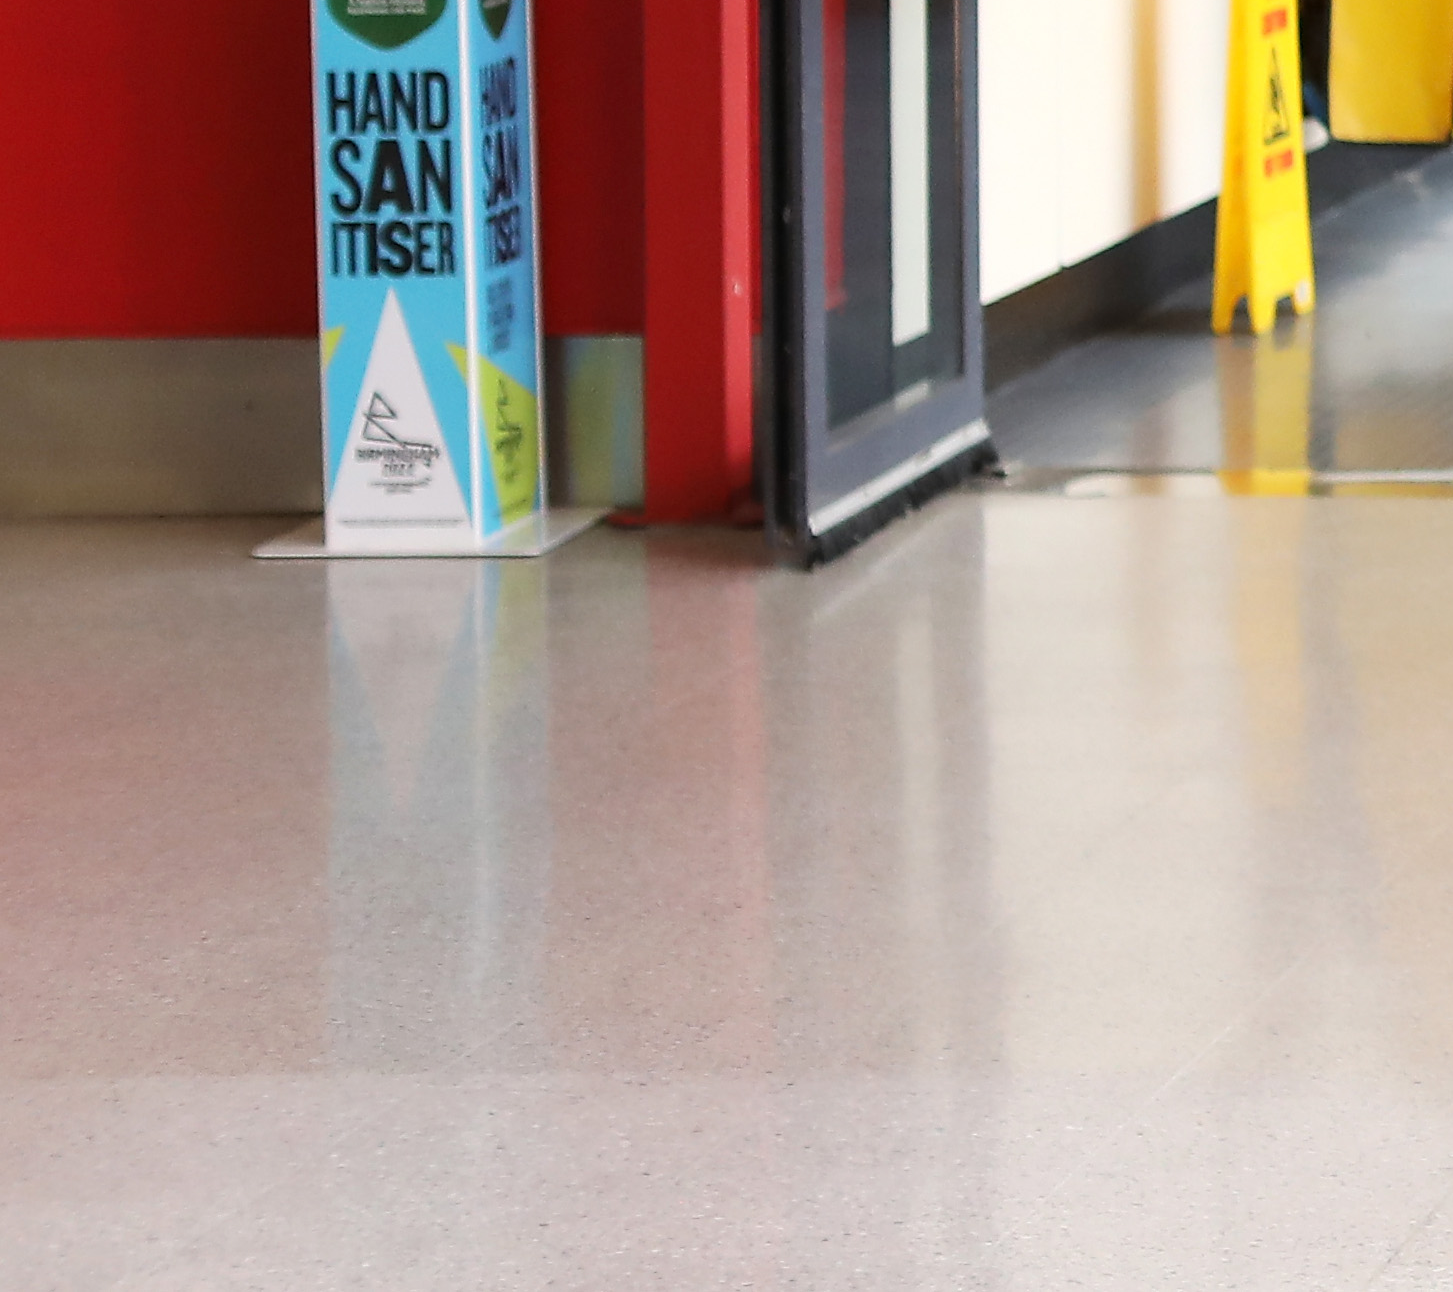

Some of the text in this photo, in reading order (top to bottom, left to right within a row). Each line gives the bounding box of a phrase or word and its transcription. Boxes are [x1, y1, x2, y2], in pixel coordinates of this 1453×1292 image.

[326, 69, 450, 134] HAND
[330, 138, 453, 216] SAN
[331, 219, 457, 278] ITISER
